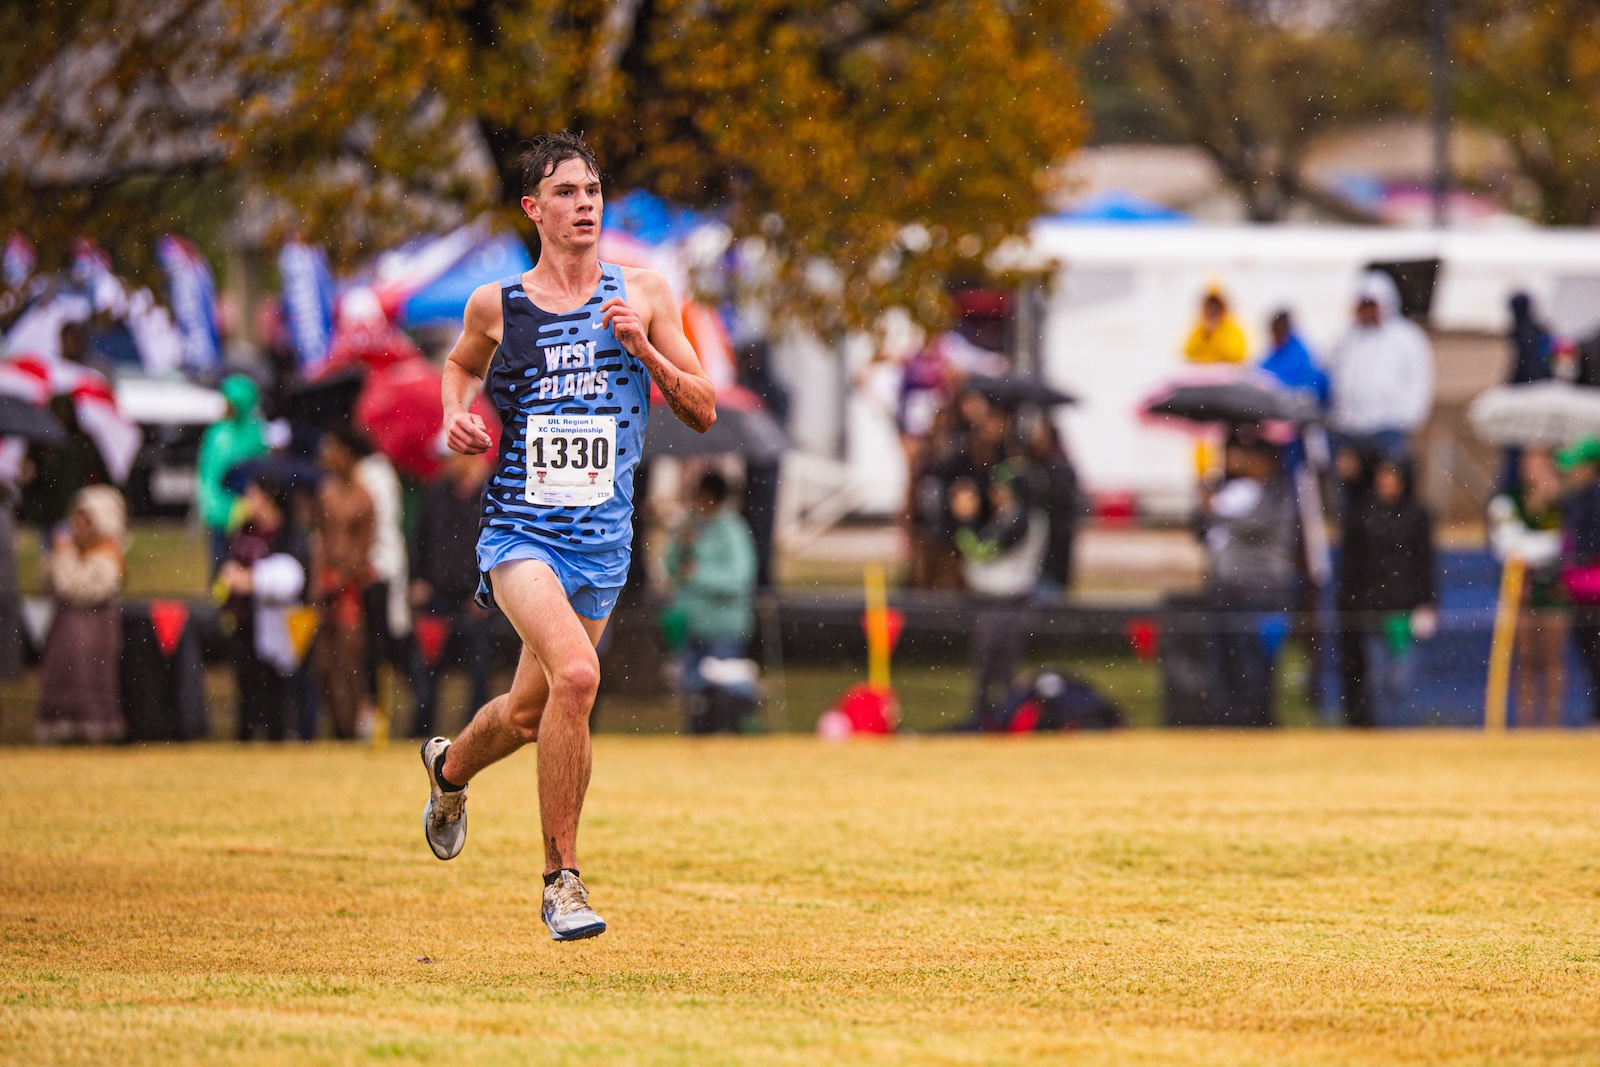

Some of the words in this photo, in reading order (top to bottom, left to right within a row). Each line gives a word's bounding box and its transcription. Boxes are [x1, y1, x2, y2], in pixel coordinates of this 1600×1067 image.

[544, 341, 596, 372] WEST
[538, 370, 609, 400] PLAINS
[550, 426, 604, 434] Championship
[563, 418, 589, 426] Region
[532, 436, 609, 469] 1330
